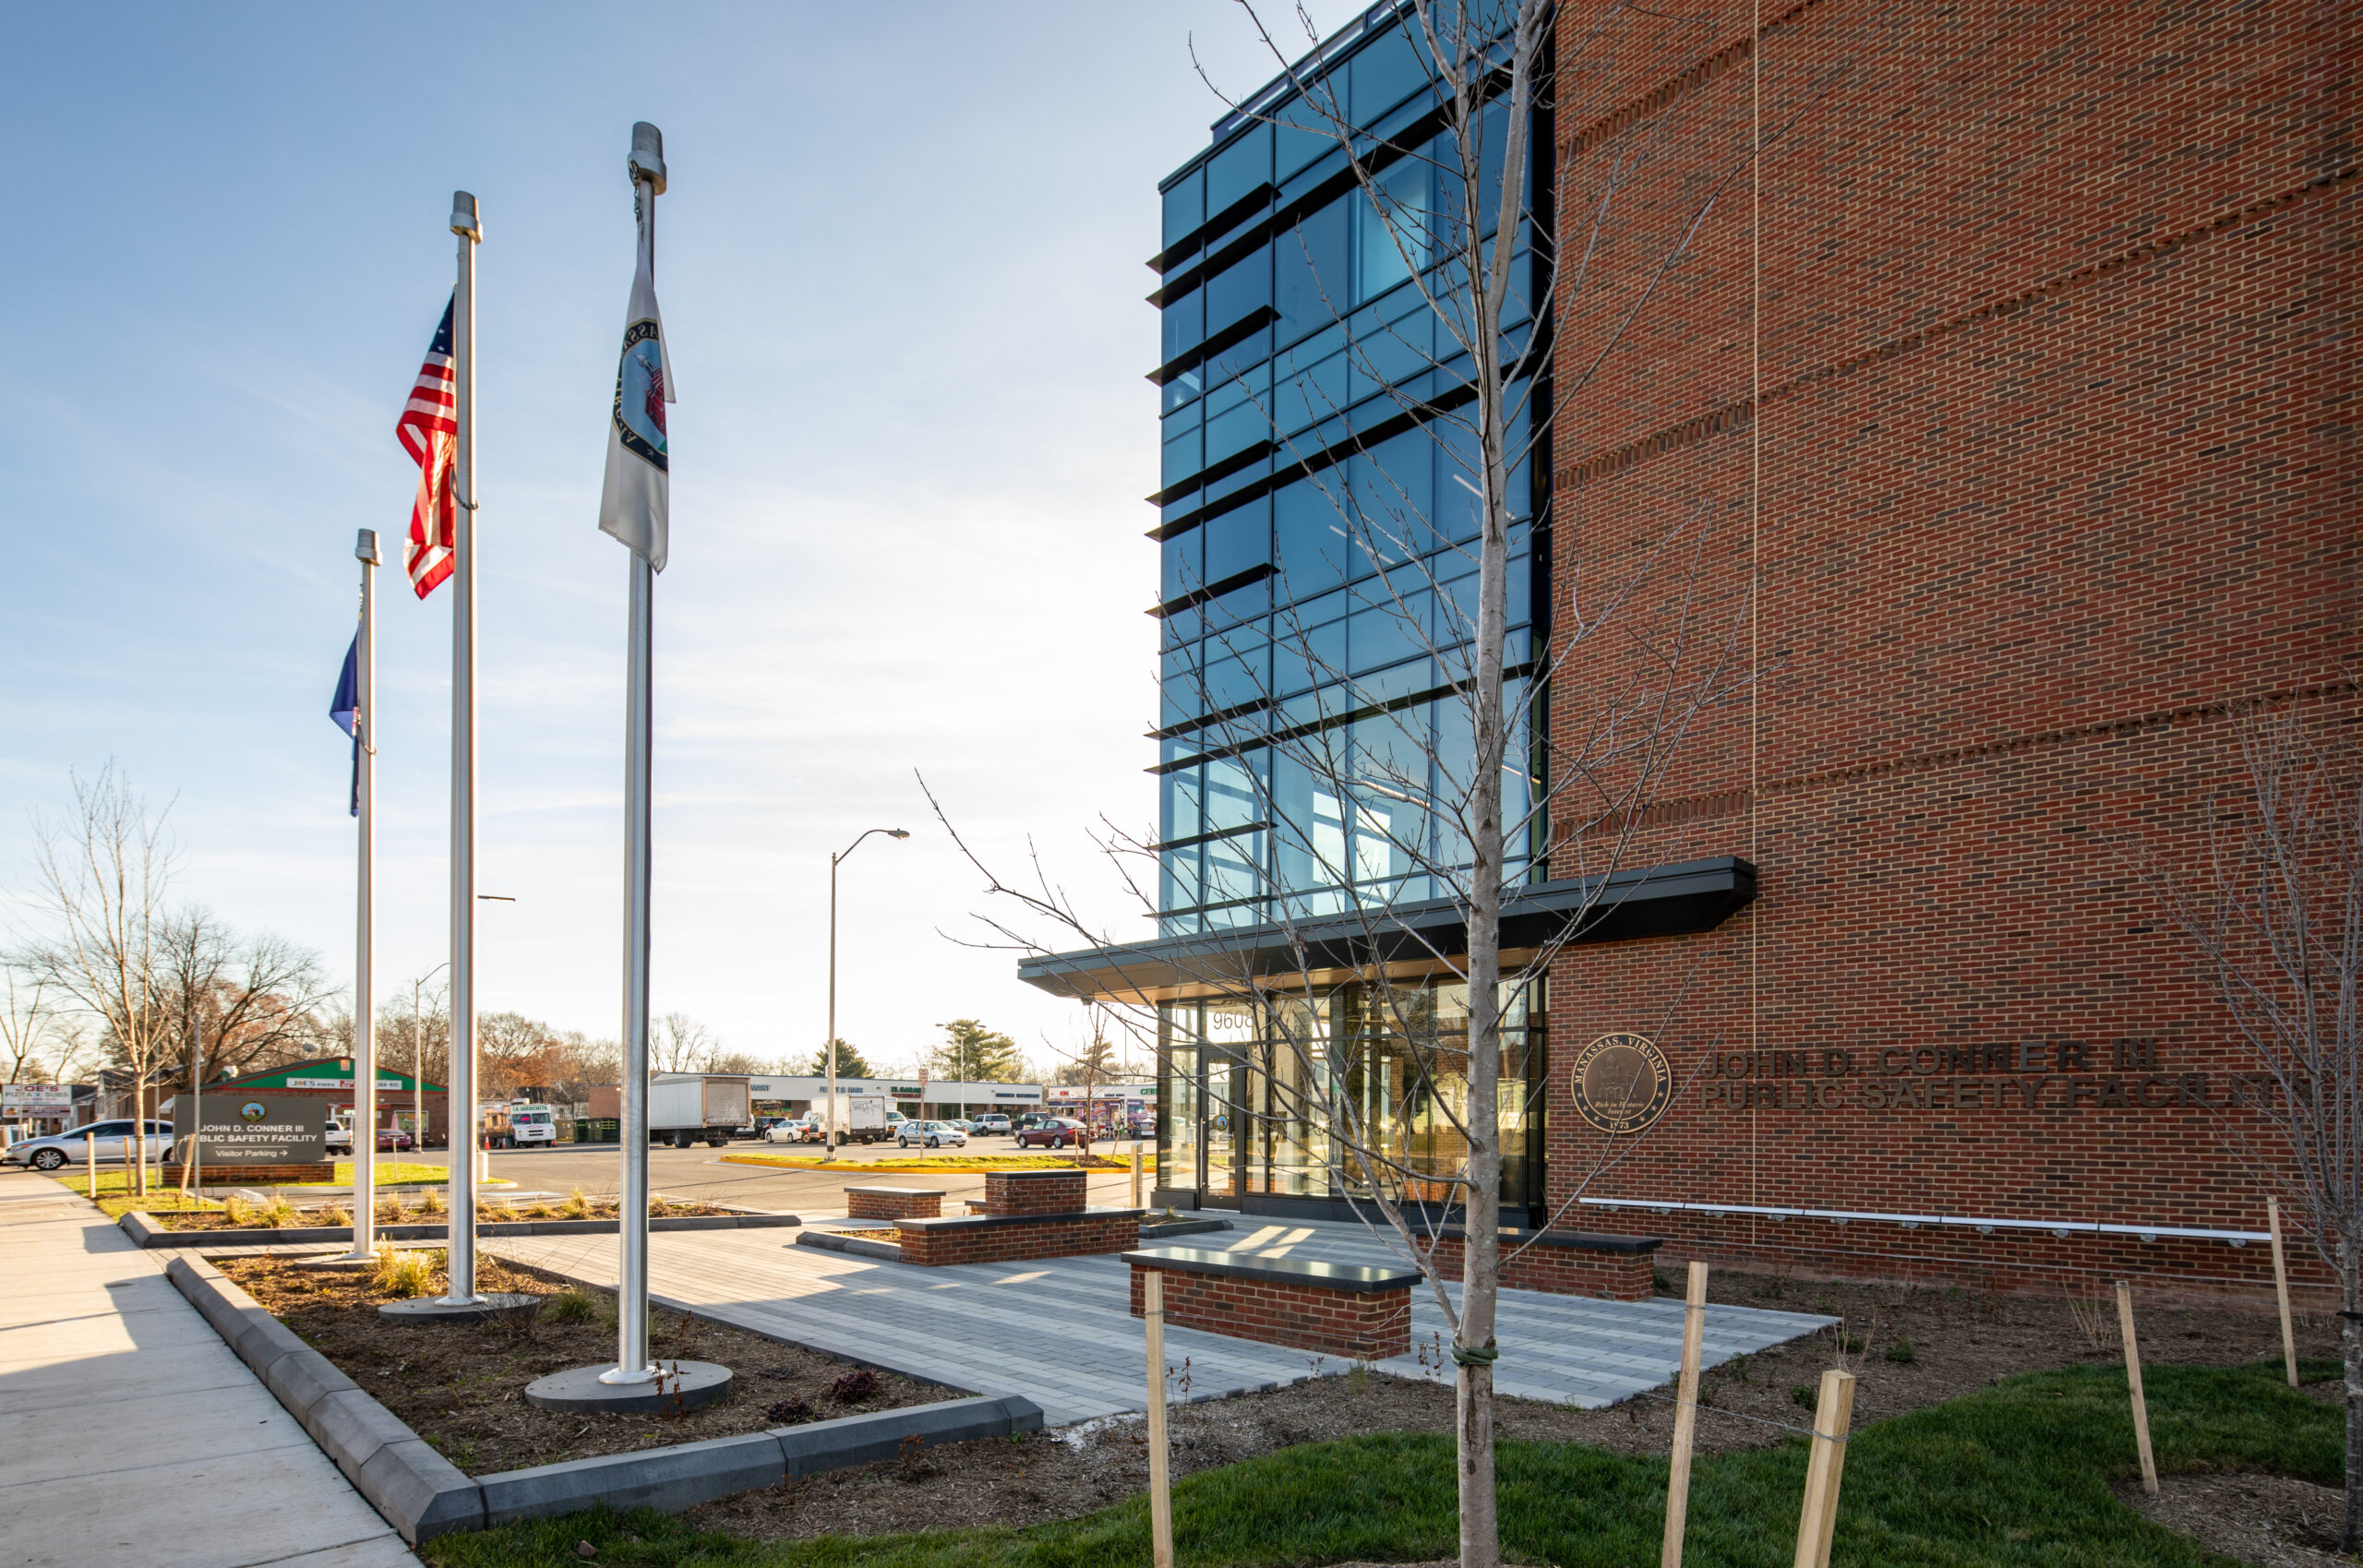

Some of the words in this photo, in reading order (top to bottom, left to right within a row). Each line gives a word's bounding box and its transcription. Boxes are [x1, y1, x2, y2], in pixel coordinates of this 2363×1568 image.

[1213, 1011, 1253, 1029] 9608
[1627, 1036, 1667, 1083] VIRGINIA
[1701, 1049, 1805, 1079] JOHN
[1822, 1047, 1860, 1076] D.
[1877, 1040, 2089, 1074] CONNER
[2113, 1037, 2155, 1071] III
[1700, 1080, 1843, 1108] PUBLIC
[1861, 1078, 2045, 1108] SAFETY
[246, 1150, 277, 1158] Parking
